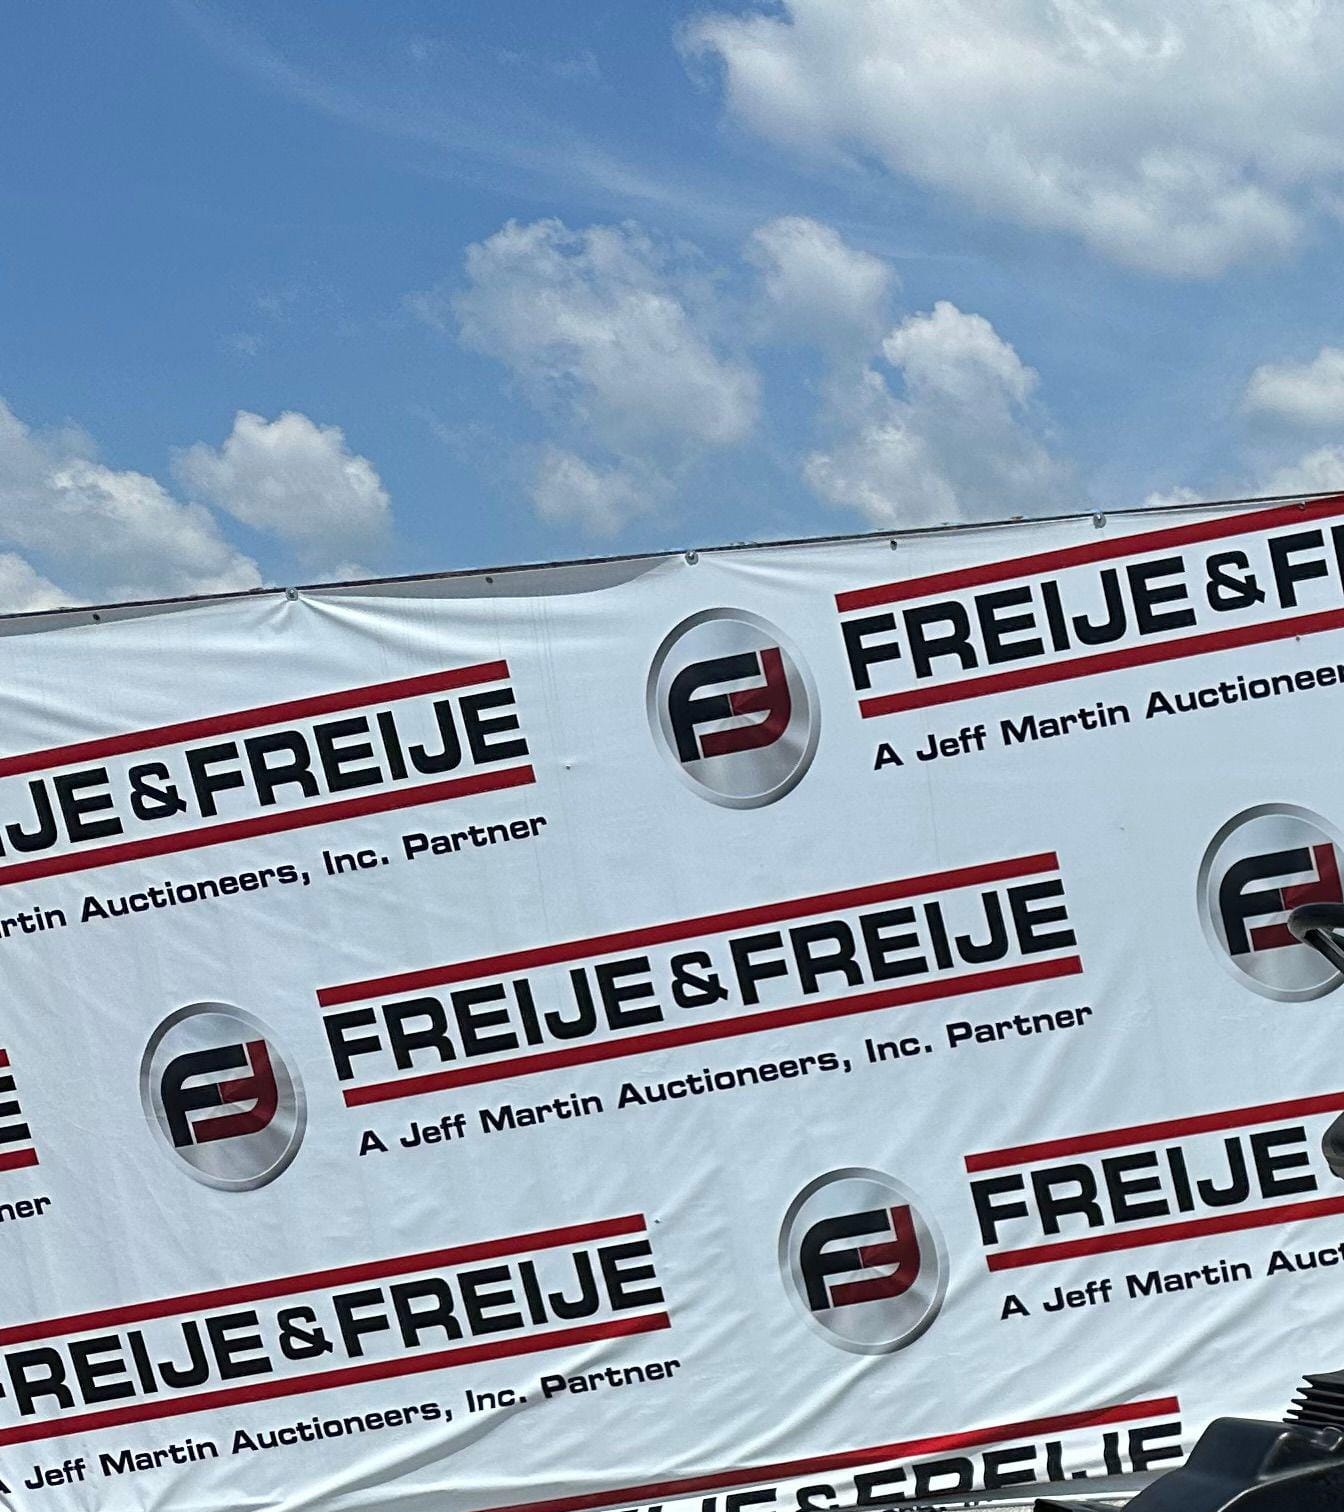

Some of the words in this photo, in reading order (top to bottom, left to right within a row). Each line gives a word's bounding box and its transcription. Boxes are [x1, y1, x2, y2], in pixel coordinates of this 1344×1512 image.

[841, 556, 1196, 690] FREIJE
[1206, 551, 1265, 611] &
[129, 763, 186, 820] &
[185, 688, 529, 817] FREIJE
[874, 743, 904, 770] A
[917, 725, 986, 761] Jeff
[1000, 703, 1130, 745] Martin
[0, 907, 66, 938] rtin
[81, 865, 310, 922] Auctioneers,
[323, 850, 389, 875] Inc.
[402, 817, 547, 860] Partner
[323, 956, 664, 1081] FREIJE
[671, 952, 728, 1008] &
[729, 879, 1077, 1005] FREIJE
[360, 1131, 388, 1156] A
[400, 1114, 466, 1147] Jeff
[479, 1093, 603, 1133] Martin
[618, 1053, 851, 1109] Auctioneers,
[865, 1038, 932, 1063] Inc.
[946, 1007, 1092, 1048] Partner
[970, 1126, 1317, 1245] FREIJE
[5, 1310, 273, 1416] REIJE
[277, 1307, 333, 1360] &
[333, 1240, 664, 1358] FREIJE
[1001, 1295, 1030, 1320] A
[1043, 1279, 1112, 1311] Jeff
[1126, 1260, 1251, 1298] Martin
[25, 1458, 85, 1489] Jeff
[99, 1439, 218, 1476] Martin
[232, 1403, 452, 1454] Auctioneers,
[466, 1390, 527, 1412] Inc.
[541, 1360, 680, 1399] Partner
